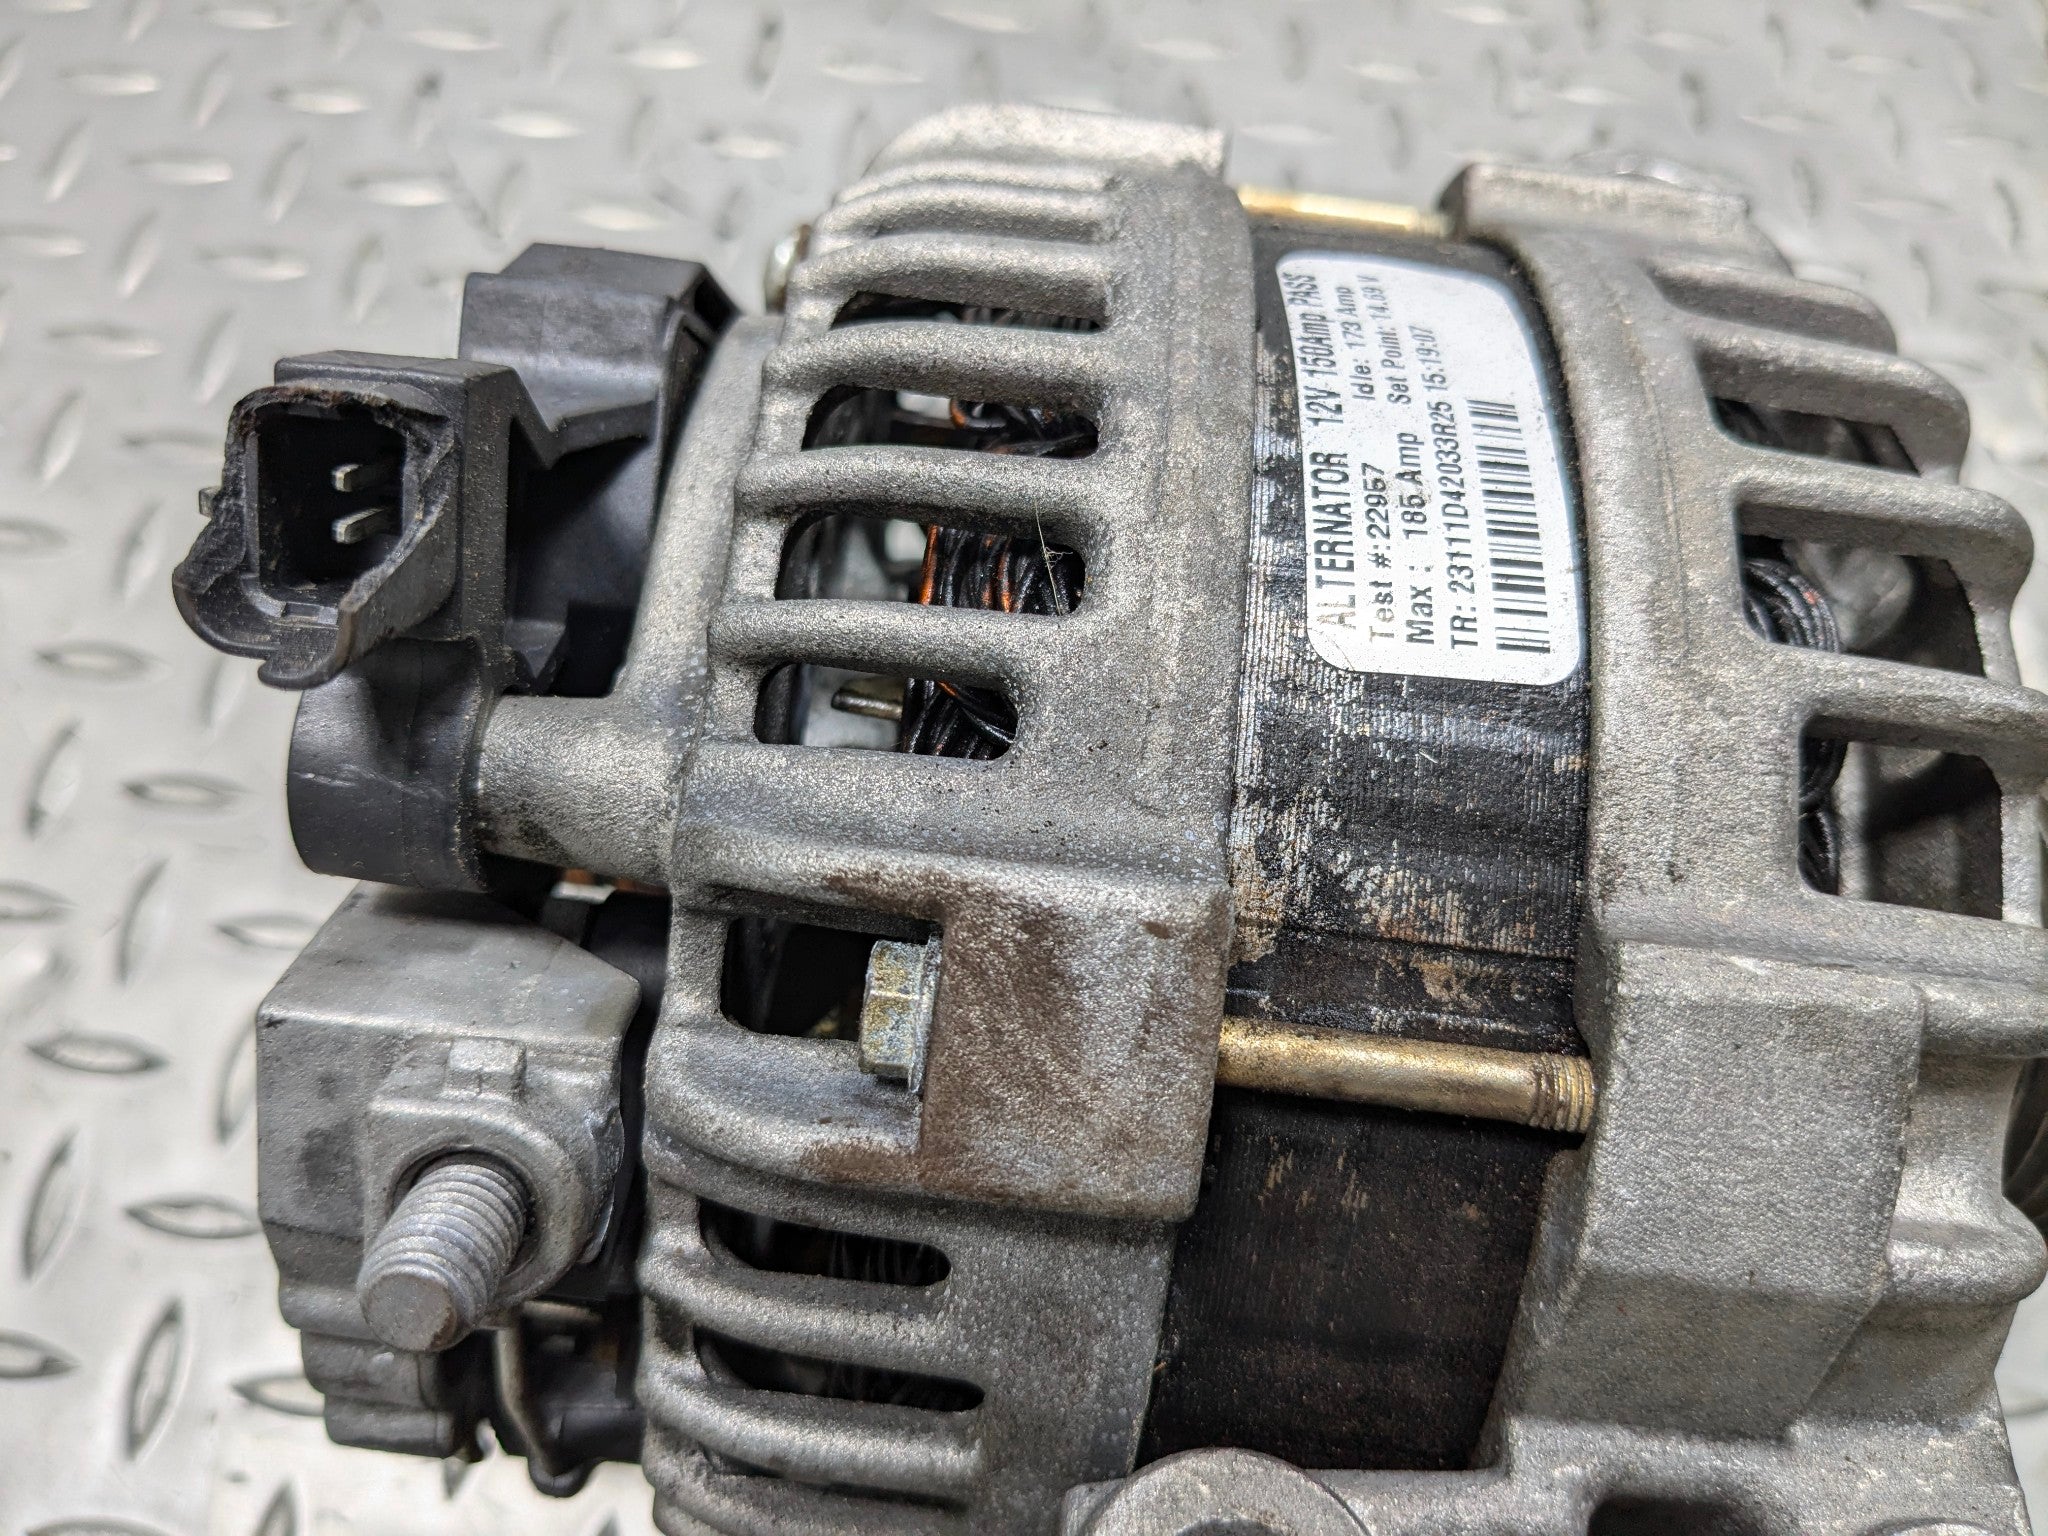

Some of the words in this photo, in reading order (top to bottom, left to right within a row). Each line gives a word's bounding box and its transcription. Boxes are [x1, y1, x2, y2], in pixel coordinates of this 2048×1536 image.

[1282, 272, 1322, 307] PASS
[1356, 275, 1379, 283] V
[1334, 287, 1358, 317] Amp
[1297, 313, 1337, 377] 150Amp
[1340, 322, 1366, 349] 173
[1377, 327, 1405, 370] Point:
[1349, 359, 1375, 400] Idle:
[1408, 325, 1448, 393] 15:19:07
[1303, 386, 1343, 426] 12V
[1384, 376, 1411, 405] Set
[1395, 433, 1424, 486] Amp
[1399, 495, 1427, 539] 185
[1427, 402, 1475, 595] 23111D42033R25
[1309, 451, 1356, 629] ALTERNATOR
[1369, 580, 1395, 643] Test
[1406, 586, 1434, 644] Max
[1450, 607, 1478, 649] TR:
